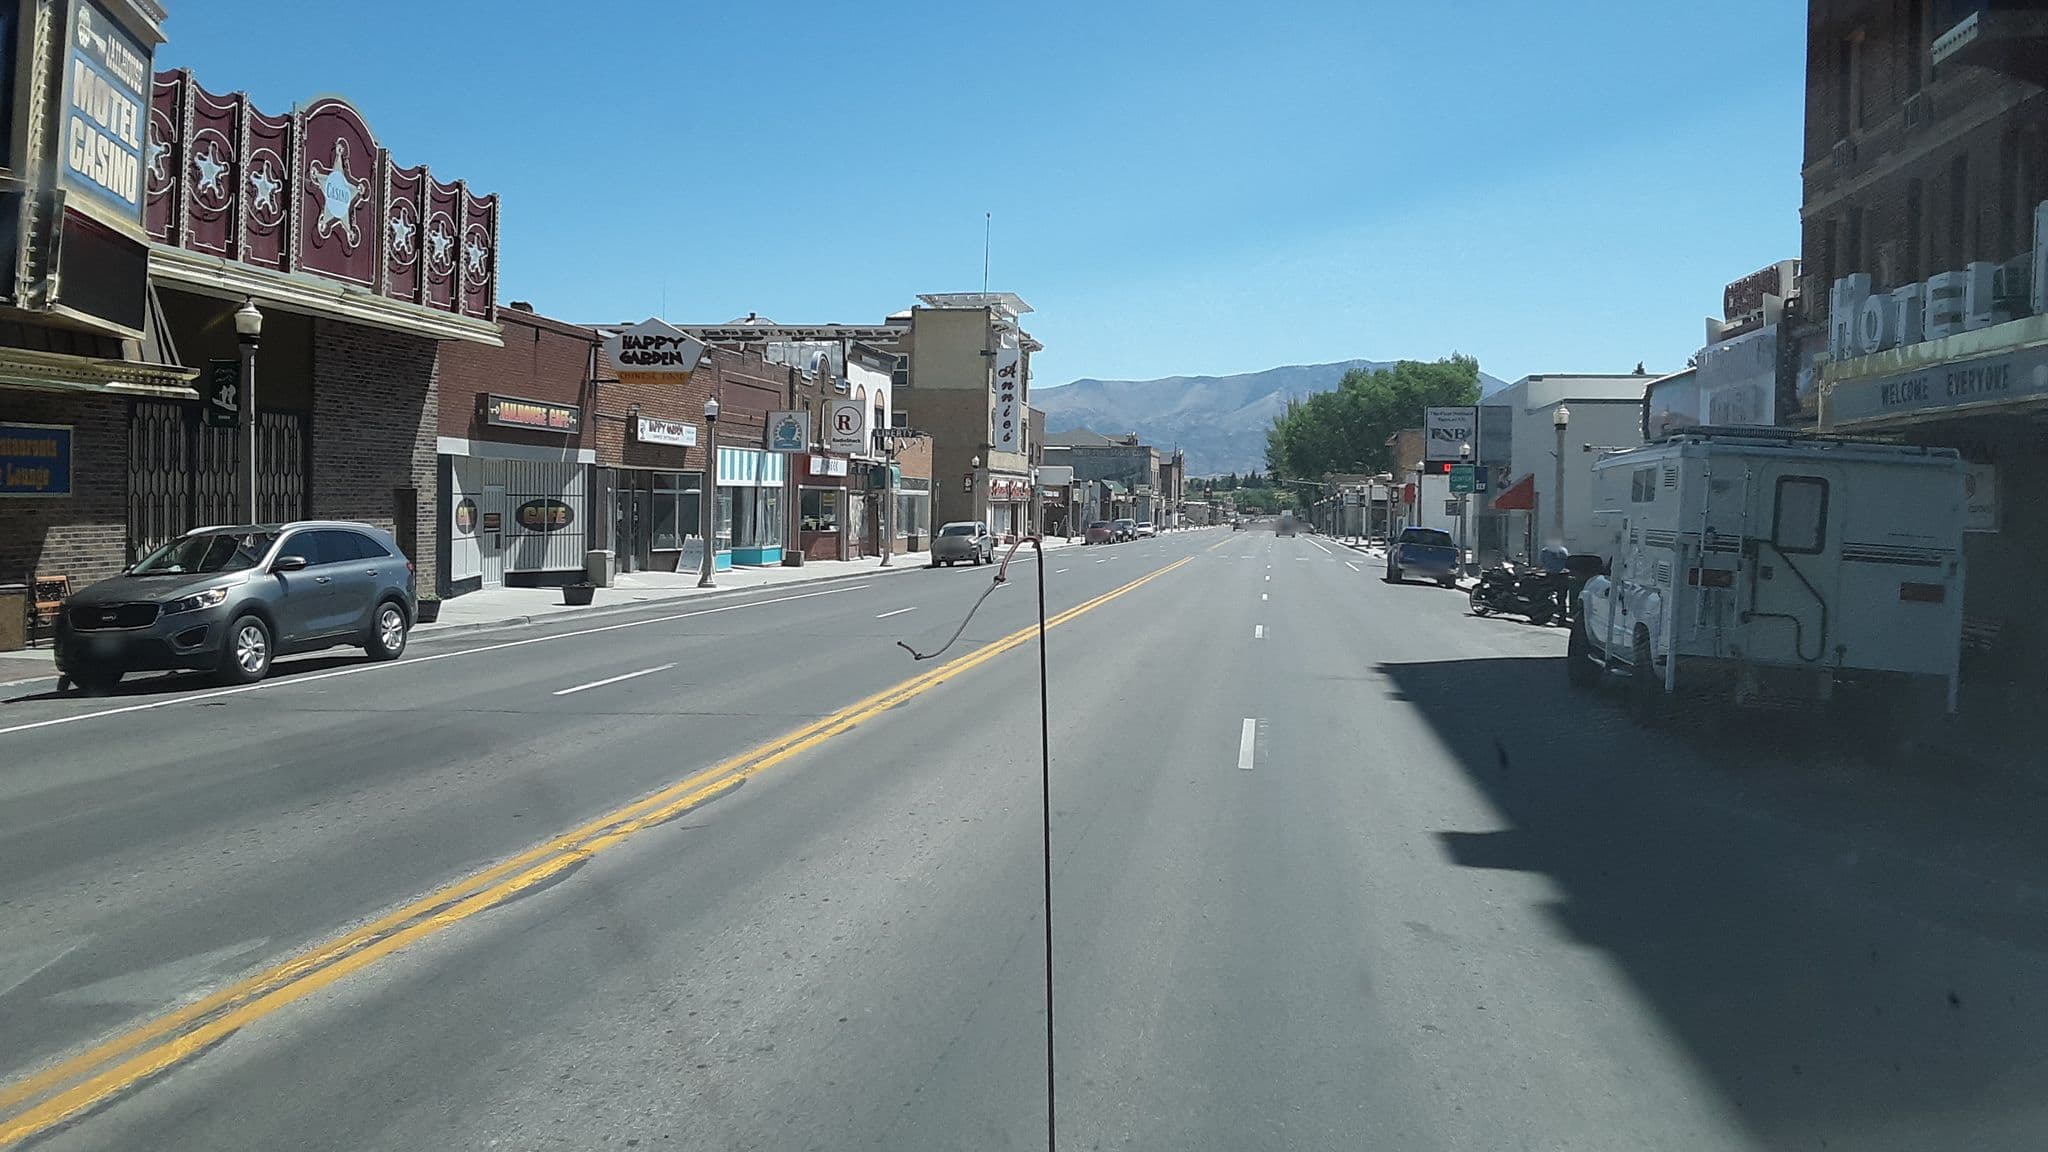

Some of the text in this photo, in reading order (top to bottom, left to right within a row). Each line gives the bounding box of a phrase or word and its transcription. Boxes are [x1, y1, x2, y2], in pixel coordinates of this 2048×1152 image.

[73, 58, 139, 150] MOTEL
[69, 116, 138, 204] CASINO
[1828, 262, 2012, 361] HOTEL
[622, 335, 686, 350] HAPPY
[619, 350, 684, 366] GARDEN
[1881, 364, 2010, 407] WELCOME EVERYONE
[837, 414, 852, 431] R
[523, 506, 566, 524] CAFE
